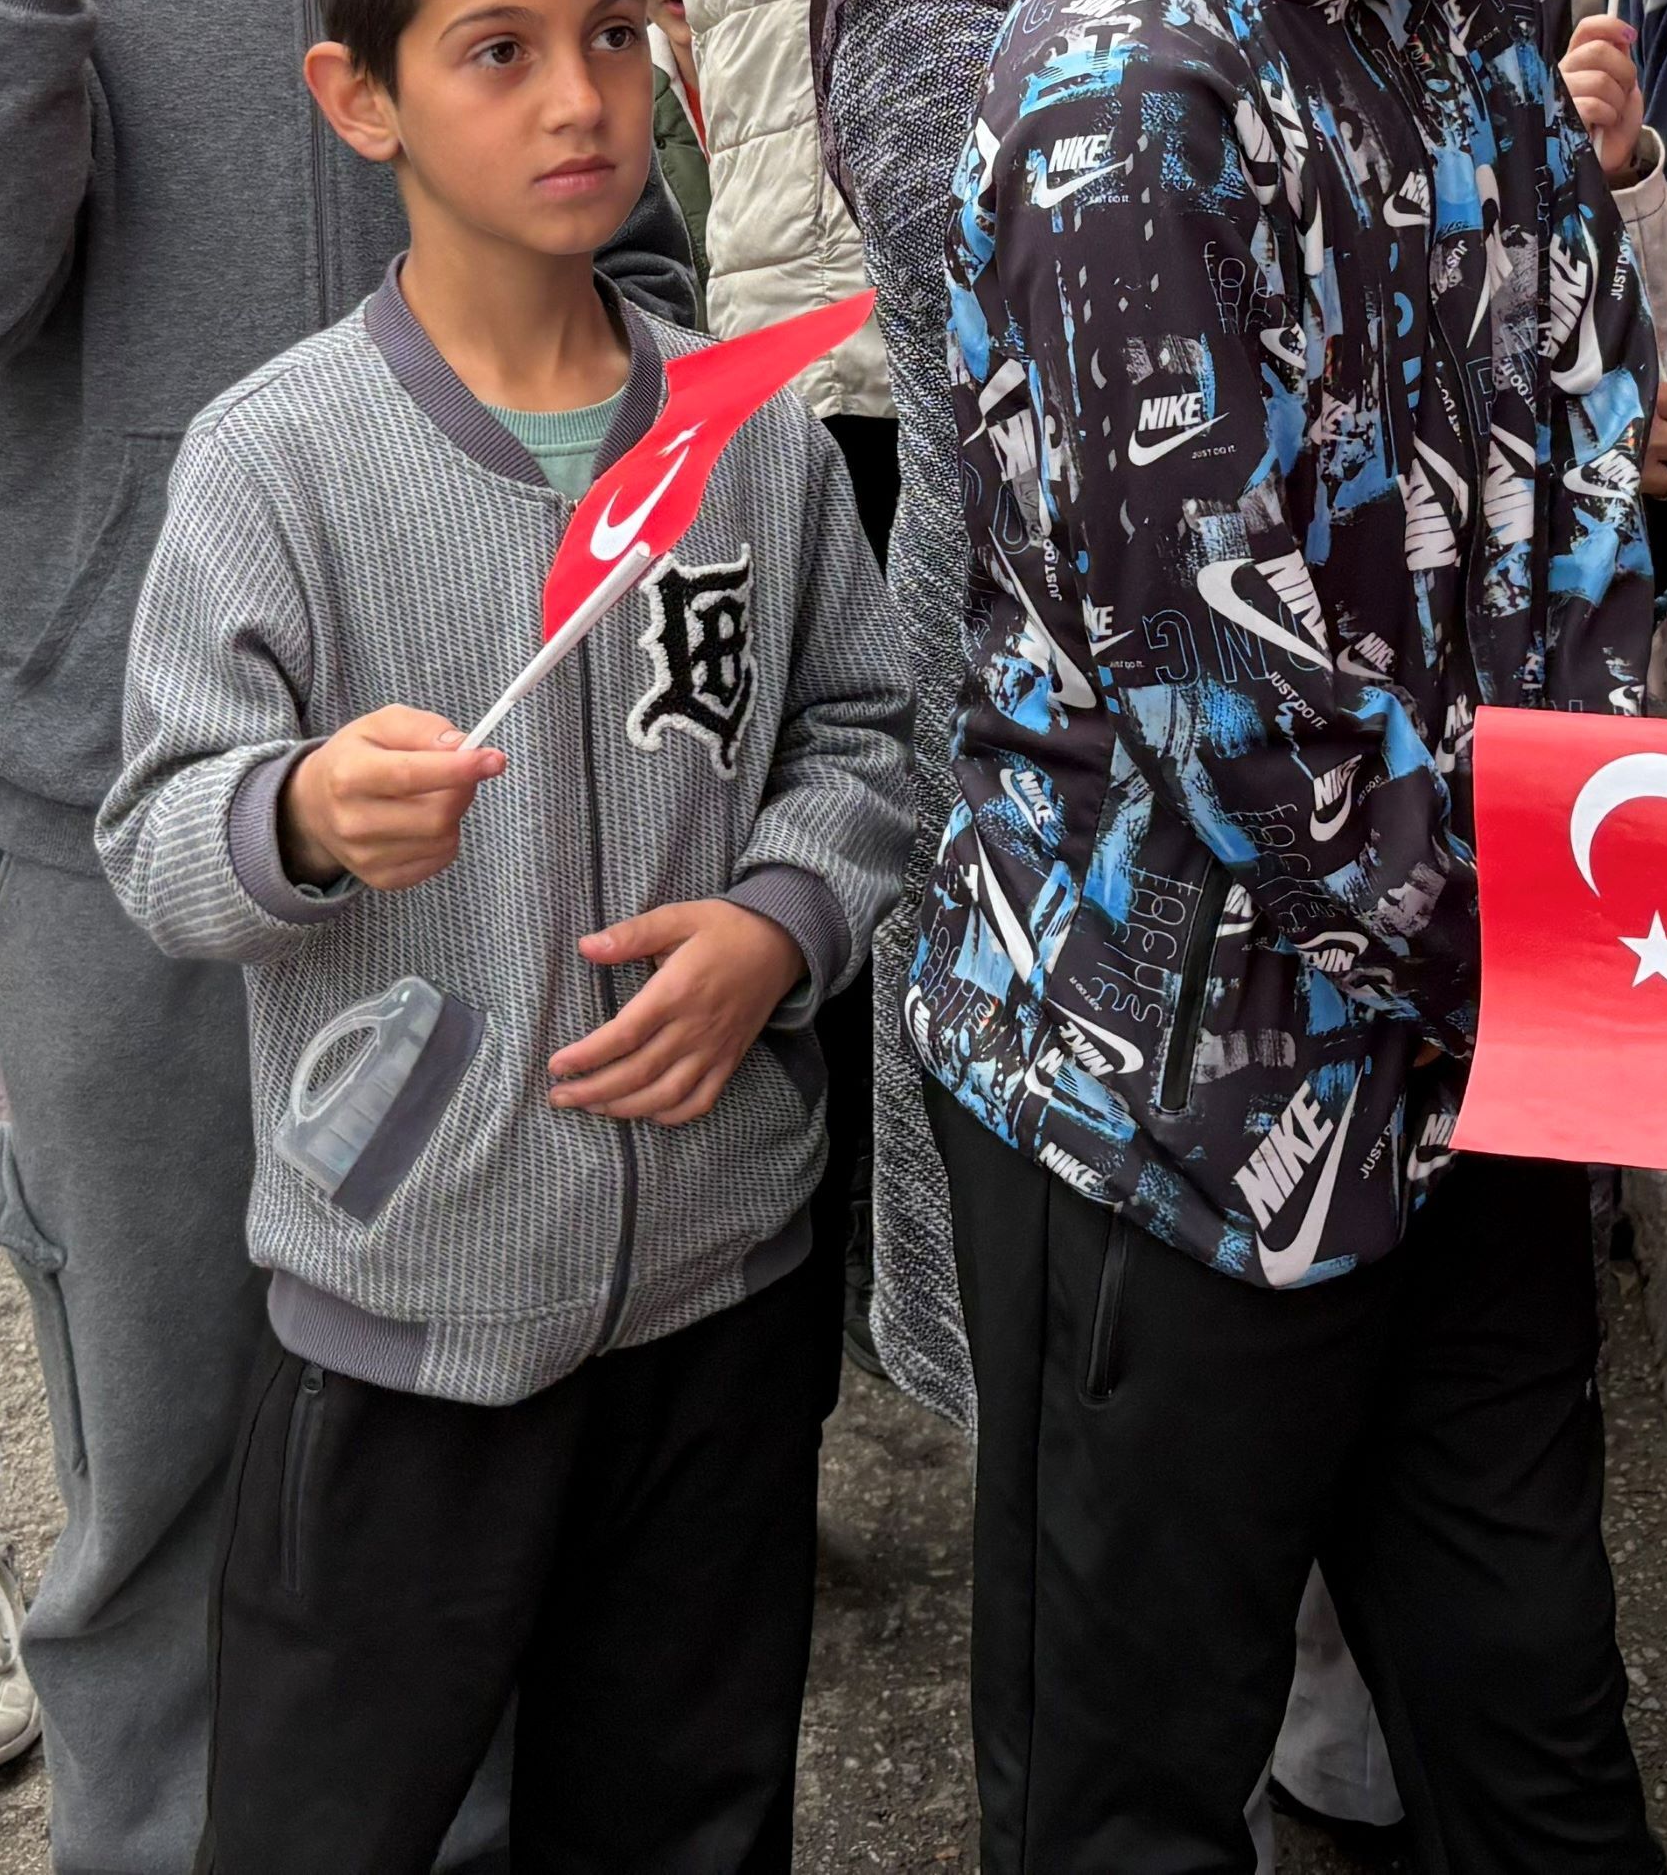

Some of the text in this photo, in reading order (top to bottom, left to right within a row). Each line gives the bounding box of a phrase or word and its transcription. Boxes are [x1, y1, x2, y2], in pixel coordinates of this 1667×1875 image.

[1048, 134, 1109, 173] NIKE
[1138, 392, 1205, 431] NIKE
[1267, 670, 1295, 706] JUST
[1293, 698, 1314, 720] DO
[1038, 1141, 1104, 1194] NIKE
[1231, 1079, 1334, 1230] NIKE
